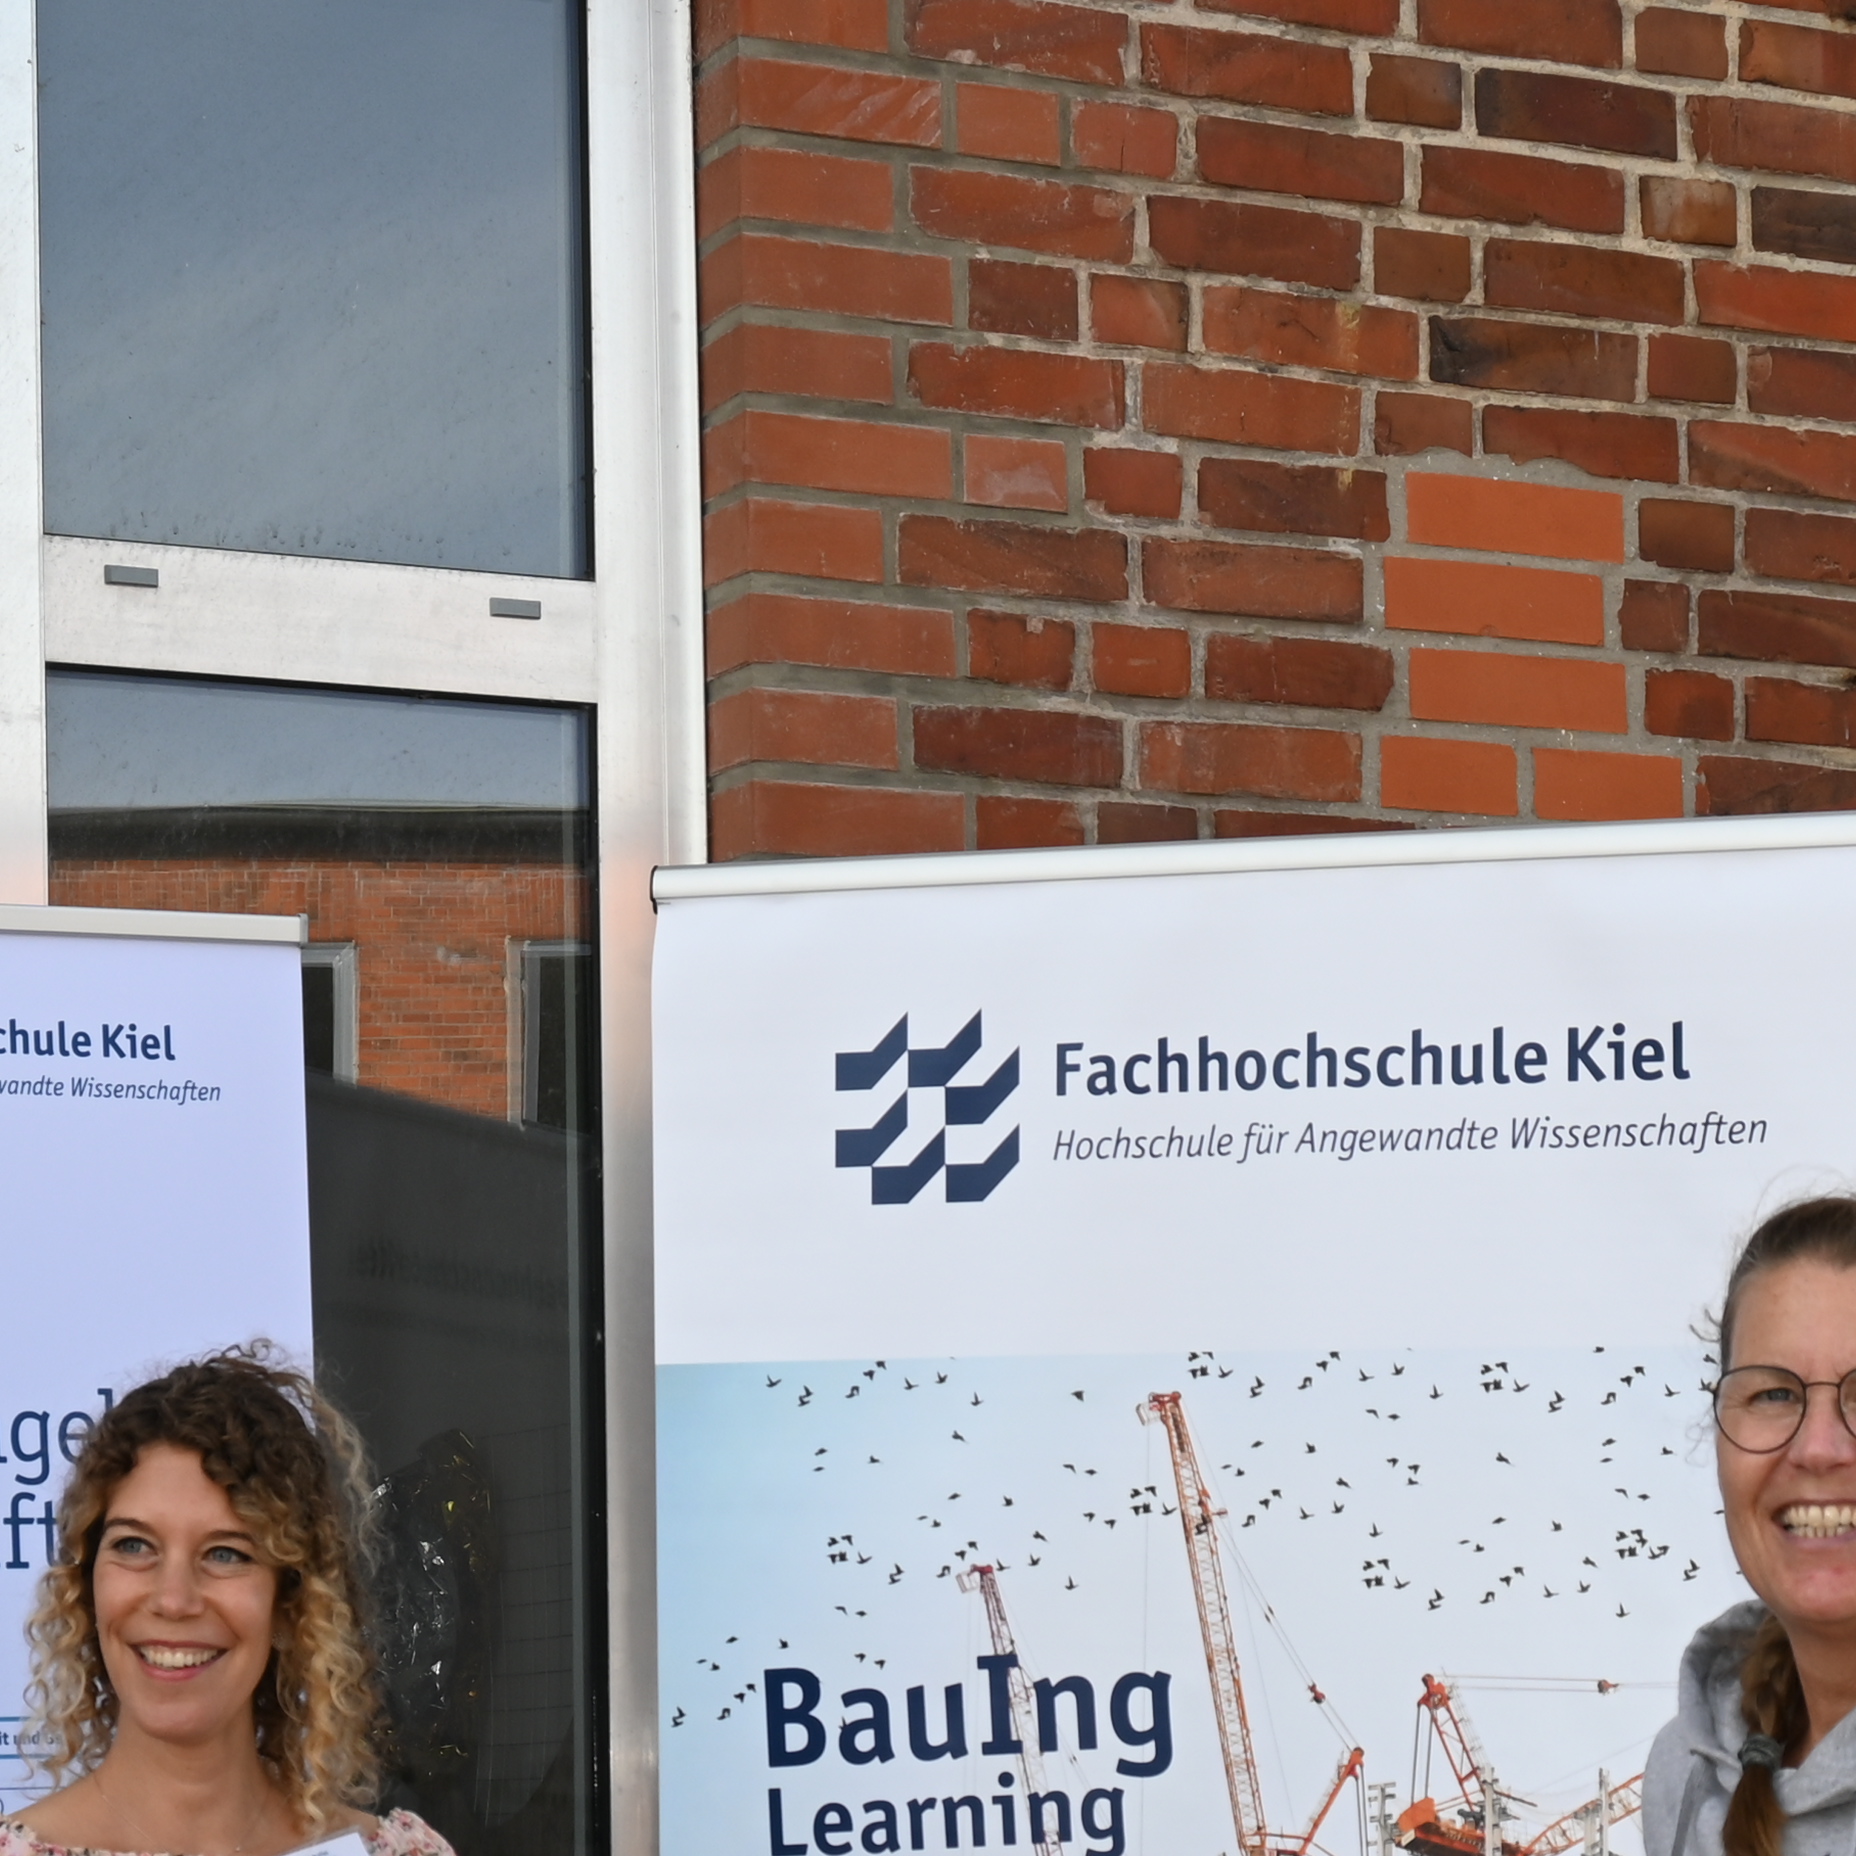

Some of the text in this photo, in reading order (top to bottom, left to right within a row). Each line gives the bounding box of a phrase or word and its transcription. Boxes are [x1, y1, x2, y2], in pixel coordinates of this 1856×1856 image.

[102, 1023, 176, 1061] Kiel
[1056, 1021, 1690, 1096] Fachhochschule Kiel
[71, 1077, 221, 1106] Wissenschaften
[1053, 1111, 1767, 1165] Hochschule für Angewandte Wissenschaften
[763, 1651, 1173, 1779] BauIng
